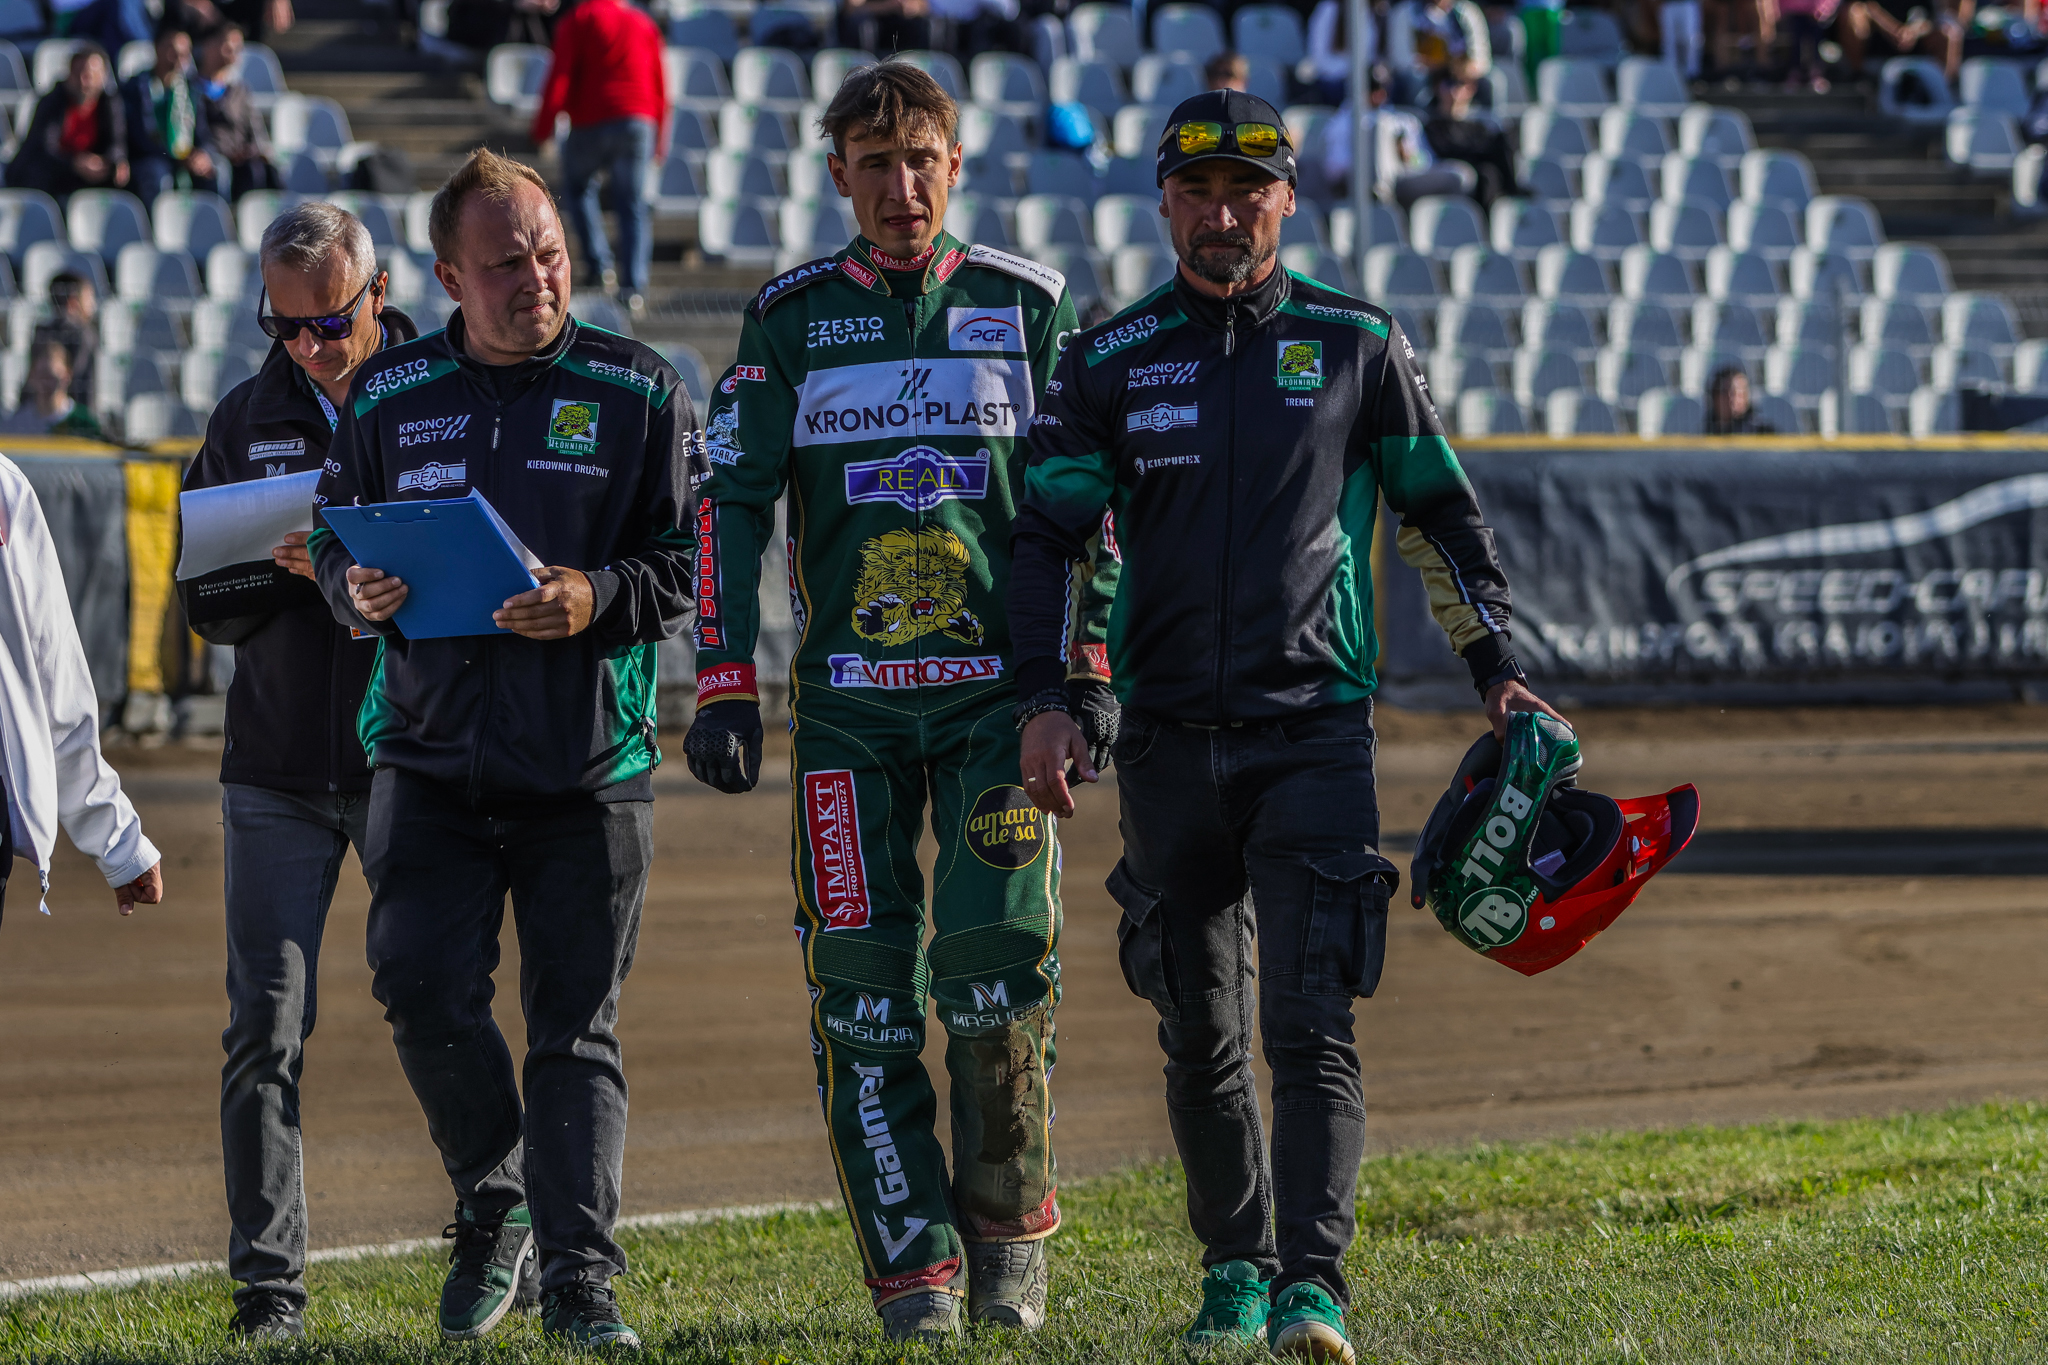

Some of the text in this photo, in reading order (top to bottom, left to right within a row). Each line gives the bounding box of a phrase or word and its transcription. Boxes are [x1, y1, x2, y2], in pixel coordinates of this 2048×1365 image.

[1305, 304, 1381, 325] SPORTGANG
[969, 329, 1007, 342] PGE
[587, 360, 659, 391] SPORTGANG
[1128, 363, 1175, 378] KRONO
[1285, 398, 1314, 407] TRENER
[399, 417, 446, 435] KRONO
[1140, 411, 1184, 425] REALL
[250, 442, 296, 453] KRONOS
[527, 460, 610, 478] KIEROWNIK DRUŻYNY
[1147, 455, 1200, 468] KIEPUREX
[410, 468, 453, 484] REALL
[878, 467, 961, 490] REALL
[198, 572, 273, 591] Mercedes-Benz
[199, 579, 274, 596] GRUPA WRÓBEL
[970, 806, 1039, 832] amaro
[815, 781, 848, 901] IMPAKT
[838, 780, 860, 897] PRODUCENT ZNICZY
[983, 825, 1037, 847] de sa
[1460, 783, 1533, 885] BOLL
[826, 1014, 915, 1043] MASURIA
[850, 1062, 910, 1206] Galmet
